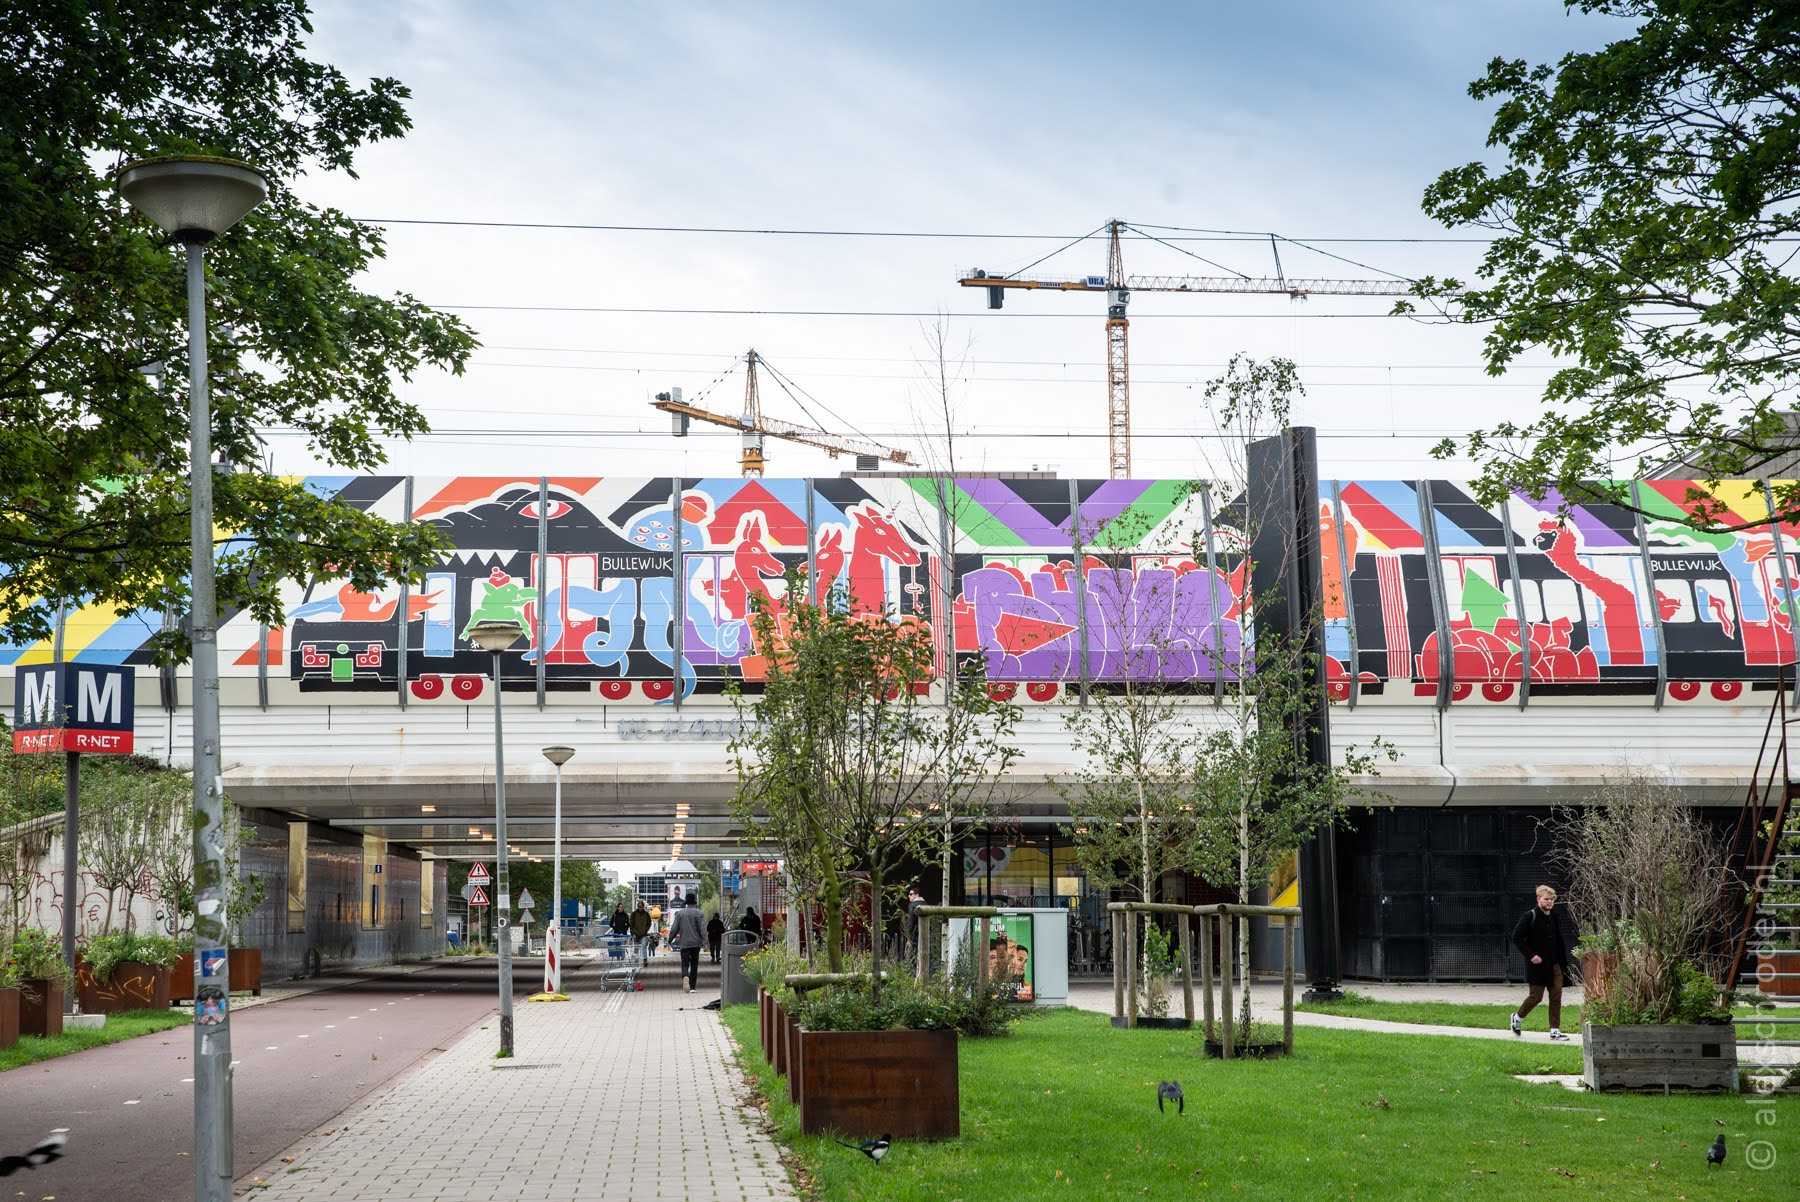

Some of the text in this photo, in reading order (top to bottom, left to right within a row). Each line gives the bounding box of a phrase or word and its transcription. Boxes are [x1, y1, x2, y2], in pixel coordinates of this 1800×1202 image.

[602, 556, 673, 571] BULLEWIJK
[1651, 559, 1722, 571] BULLEWIJK
[24, 670, 56, 723] M
[77, 670, 122, 724] M
[974, 924, 1005, 932] MEUM
